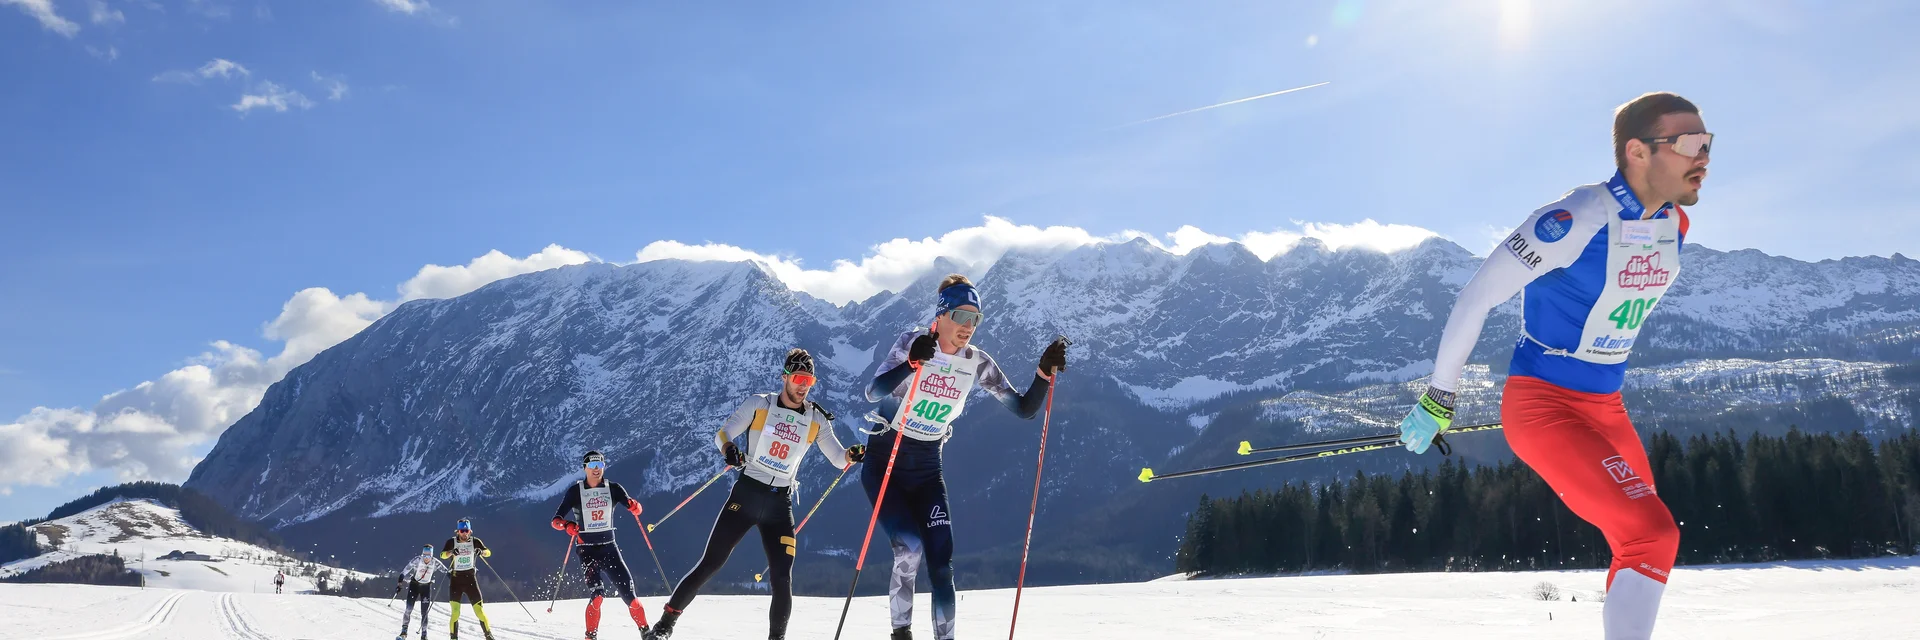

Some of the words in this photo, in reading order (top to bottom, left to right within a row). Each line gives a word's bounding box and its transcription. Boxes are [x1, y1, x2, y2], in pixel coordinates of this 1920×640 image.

[1507, 232, 1542, 268] POLAR
[1628, 255, 1648, 272] die
[1619, 268, 1669, 289] tauplitz
[927, 375, 944, 387] die
[922, 383, 960, 398] tauplitz
[912, 399, 953, 424] 402
[776, 423, 789, 432] die
[774, 430, 800, 443] auplitz
[769, 440, 790, 460] 86
[758, 455, 790, 471] steiralauf
[591, 509, 604, 521] 52
[927, 519, 952, 528] Löffler
